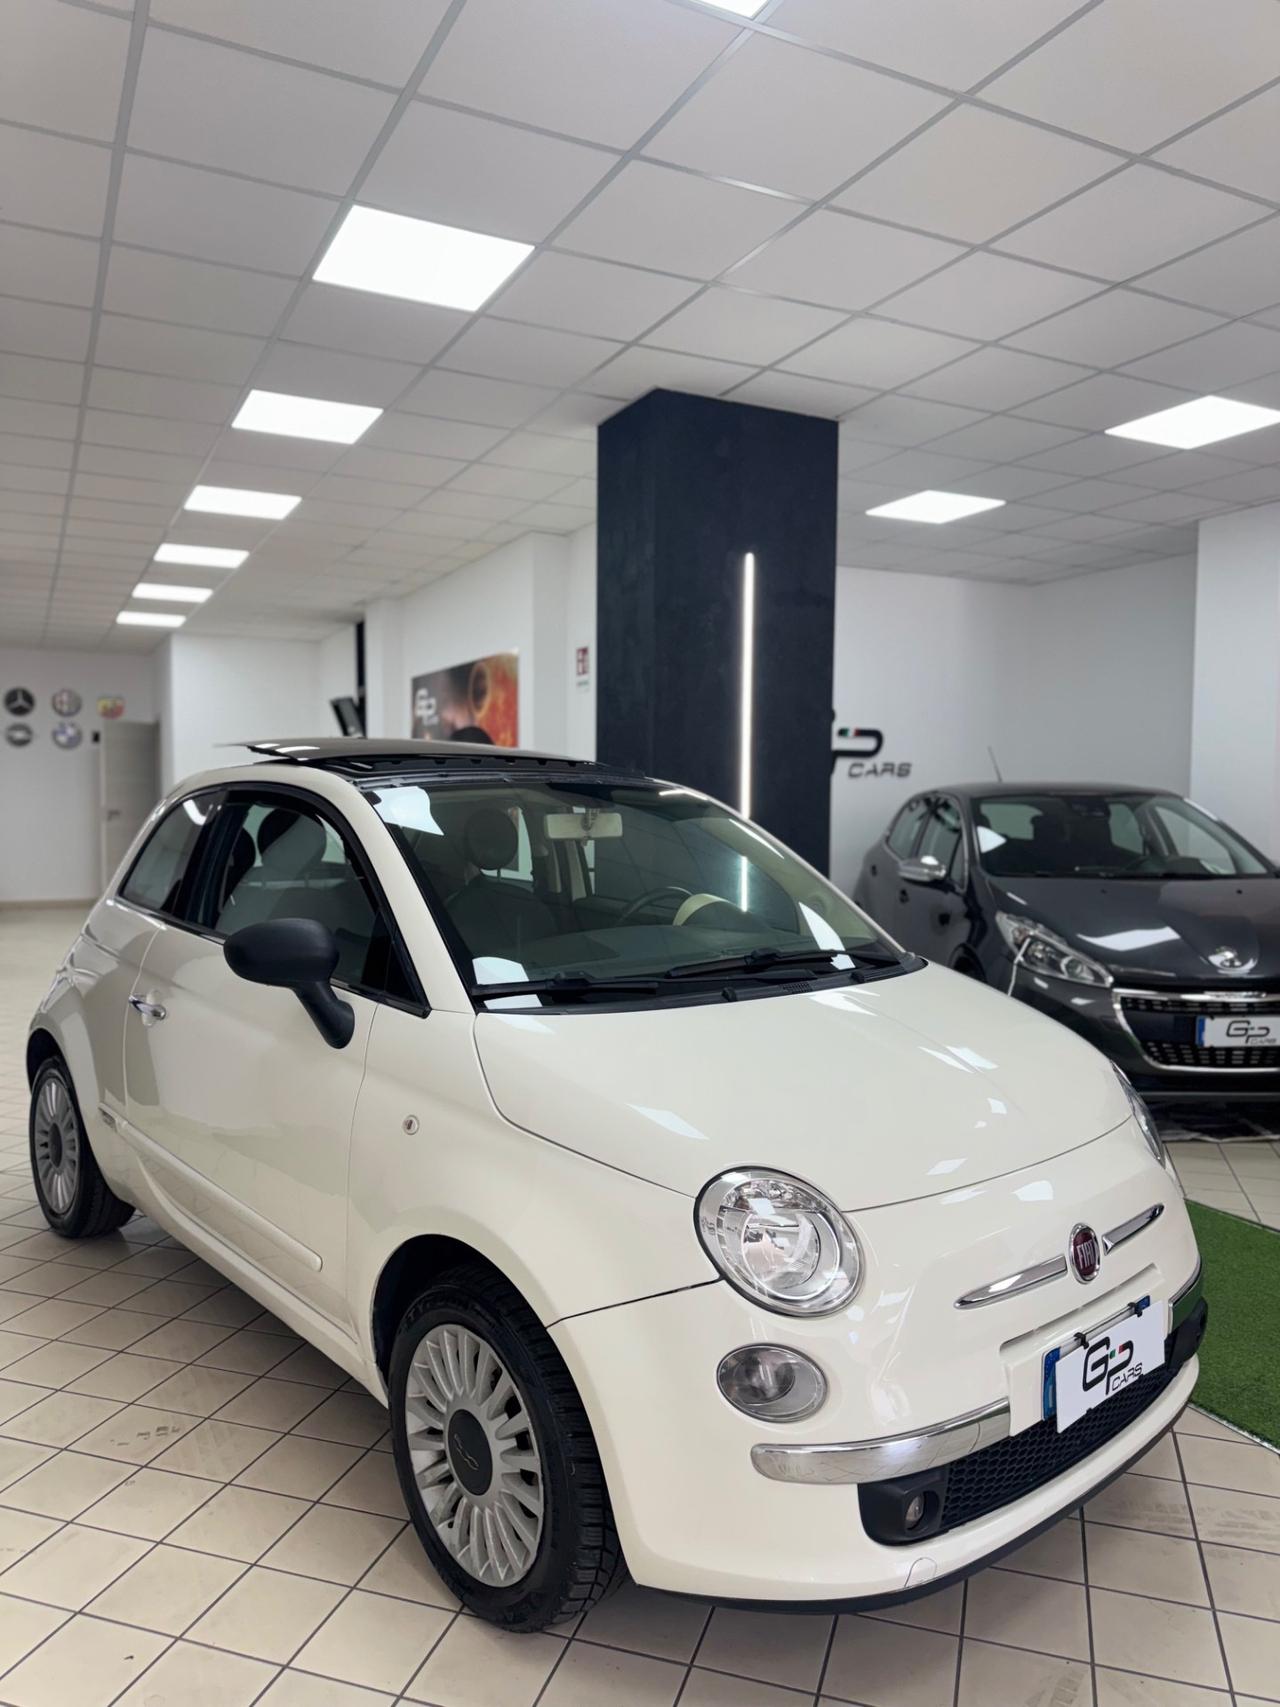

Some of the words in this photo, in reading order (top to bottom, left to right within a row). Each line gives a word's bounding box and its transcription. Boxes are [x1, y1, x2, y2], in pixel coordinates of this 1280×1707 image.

[848, 761, 912, 779] CARS
[1226, 1020, 1271, 1044] GP
[1076, 1239, 1095, 1270] FIAT
[1082, 1336, 1134, 1396] GP
[1111, 1362, 1143, 1392] CARS
